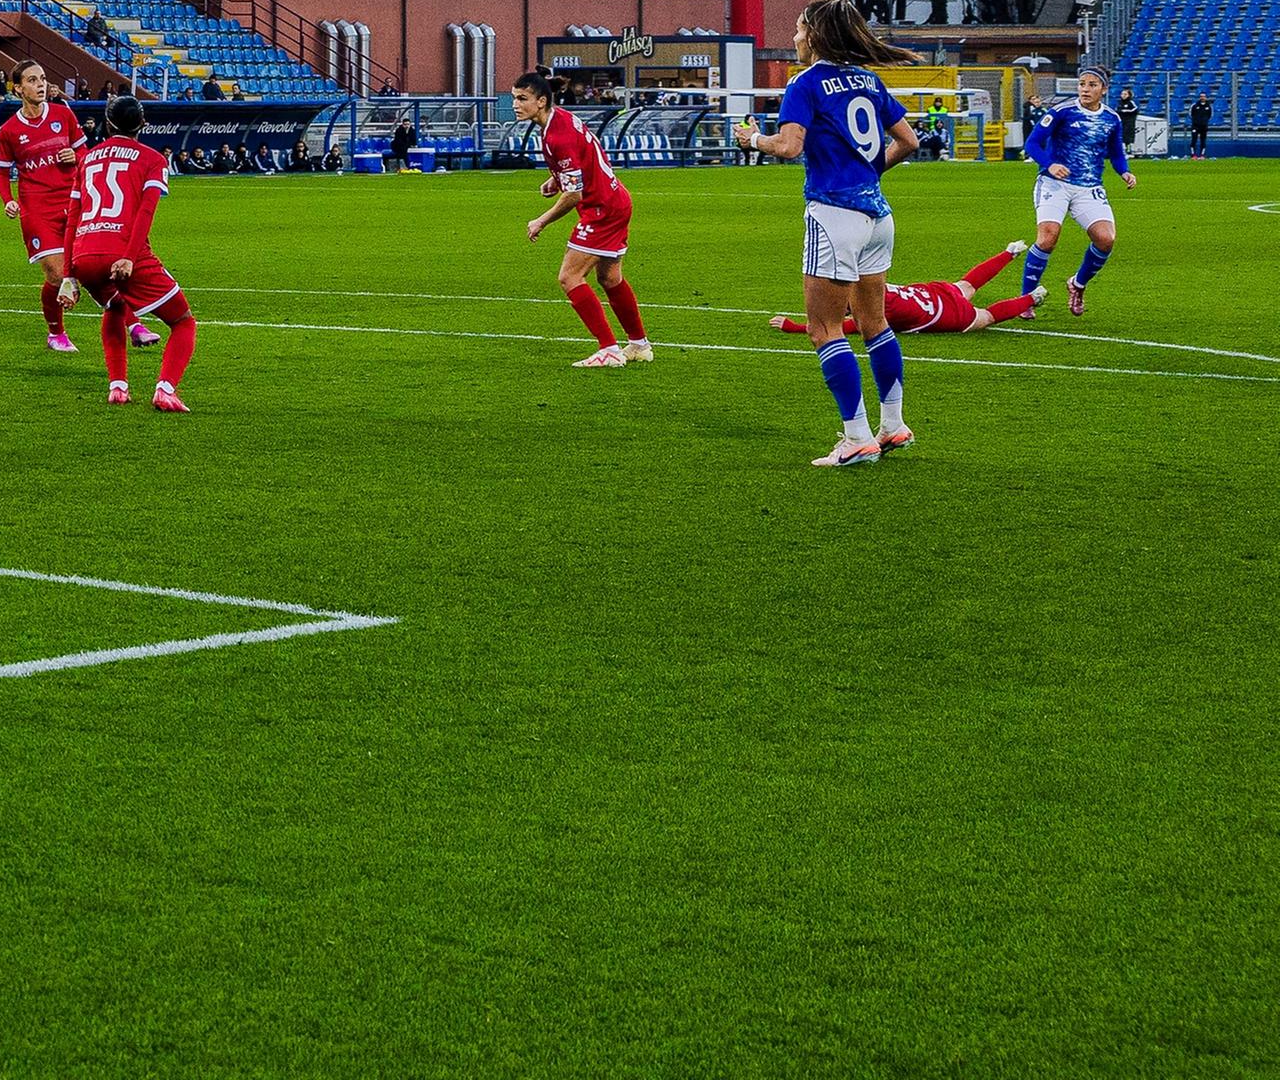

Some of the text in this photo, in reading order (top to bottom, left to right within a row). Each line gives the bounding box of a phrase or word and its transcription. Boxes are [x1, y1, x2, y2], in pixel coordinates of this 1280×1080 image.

[623, 27, 635, 40] LA
[553, 56, 580, 67] CASSA
[682, 56, 709, 66] CASSA
[821, 75, 880, 95] DEL ESTAL
[138, 122, 180, 134] Revolut
[198, 122, 239, 134] Revolut
[257, 121, 297, 134] Revolut
[847, 96, 880, 162] 9
[109, 145, 140, 161] PINDO
[81, 162, 130, 222] 55
